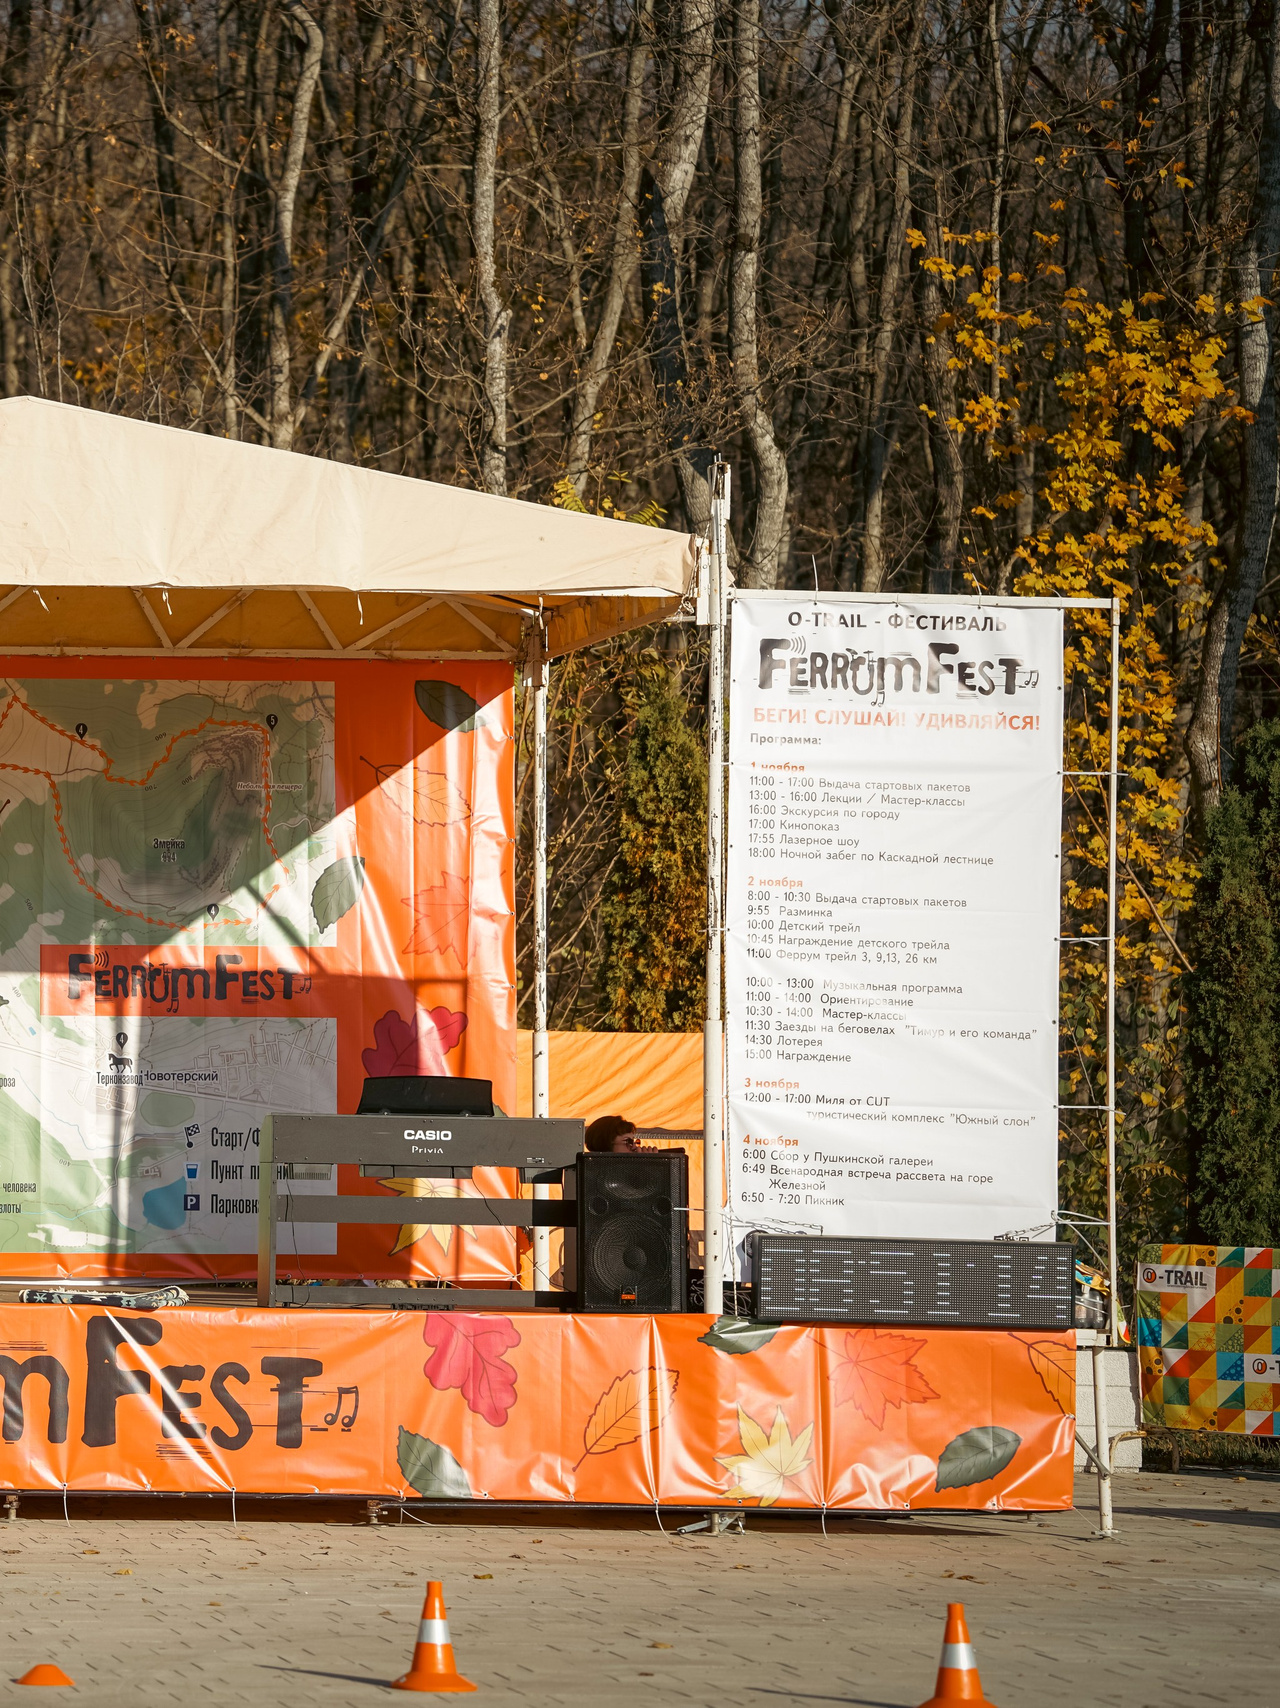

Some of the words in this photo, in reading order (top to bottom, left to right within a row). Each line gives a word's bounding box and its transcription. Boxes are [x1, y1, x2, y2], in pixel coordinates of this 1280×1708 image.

[887, 612, 1007, 632] ФЕСТИВАЛЬ
[754, 707, 807, 724] БЕГИ!
[814, 709, 905, 727] СЛУШАЙ!
[917, 711, 1040, 731] УДИВЛЯЙСЯ!
[750, 732, 822, 746] Программа:
[750, 775, 775, 786] 11:00
[788, 776, 814, 788] 17:00
[819, 778, 861, 790] Выдача
[864, 782, 922, 792] стартовых
[927, 784, 971, 792] пакетов
[749, 804, 776, 815] 16:00
[780, 804, 839, 819] Экскурсия
[843, 810, 857, 818] по
[861, 810, 900, 821] городу
[748, 818, 776, 830] 17:00
[780, 819, 840, 832] Кинопоказ
[153, 837, 186, 849] Змейка
[748, 832, 775, 844] 17:55
[779, 833, 833, 847] Лазерное
[837, 838, 860, 849] шоу
[748, 846, 776, 858] 18:00
[780, 848, 822, 860] Ночной
[826, 849, 857, 861] забег
[860, 853, 875, 862] по
[878, 851, 939, 864] Каскадной
[943, 856, 994, 866] лестнице
[748, 875, 754, 886] 2
[759, 876, 803, 890] ноября
[747, 904, 770, 916] 9:55
[779, 905, 833, 918] Разминка
[747, 918, 774, 930] 10:00
[778, 920, 824, 932] Детский
[828, 922, 860, 934] трейл
[747, 933, 774, 944] 10:45
[778, 934, 853, 948] Награждение
[857, 940, 908, 949] детского
[911, 940, 950, 952] трейла
[746, 976, 772, 988] 10:00
[786, 977, 814, 989] 13:00
[823, 980, 897, 992] Музыкальная
[902, 984, 963, 995] программа
[744, 1092, 772, 1103] 12:00
[784, 1093, 812, 1104] 17:00
[815, 1094, 845, 1105] Миля
[849, 1098, 862, 1106] от
[866, 1096, 890, 1107] CUT
[211, 1127, 260, 1151] Старт/Ф
[403, 1130, 452, 1141] CASIO
[411, 1145, 444, 1155] Privia
[742, 1148, 766, 1160] 6:00
[770, 1150, 799, 1163] Сбор
[803, 1154, 810, 1164] у
[814, 1151, 884, 1165] Пушкинской
[889, 1157, 933, 1168] галереи
[211, 1160, 244, 1183] Пункт
[742, 1162, 766, 1174] 6:49
[770, 1164, 843, 1178] Всенародная
[848, 1170, 892, 1180] встреча
[896, 1172, 946, 1182] рассвета
[950, 1174, 964, 1182] на
[968, 1175, 994, 1185] горе
[3, 1182, 37, 1193] человека
[768, 1178, 826, 1190] Железной
[211, 1194, 260, 1217] Парковк
[741, 1191, 765, 1203] 6:50
[778, 1193, 801, 1205] 7:20
[805, 1194, 845, 1206] Пикник
[1143, 1267, 1208, 1287] O-TRAIL
